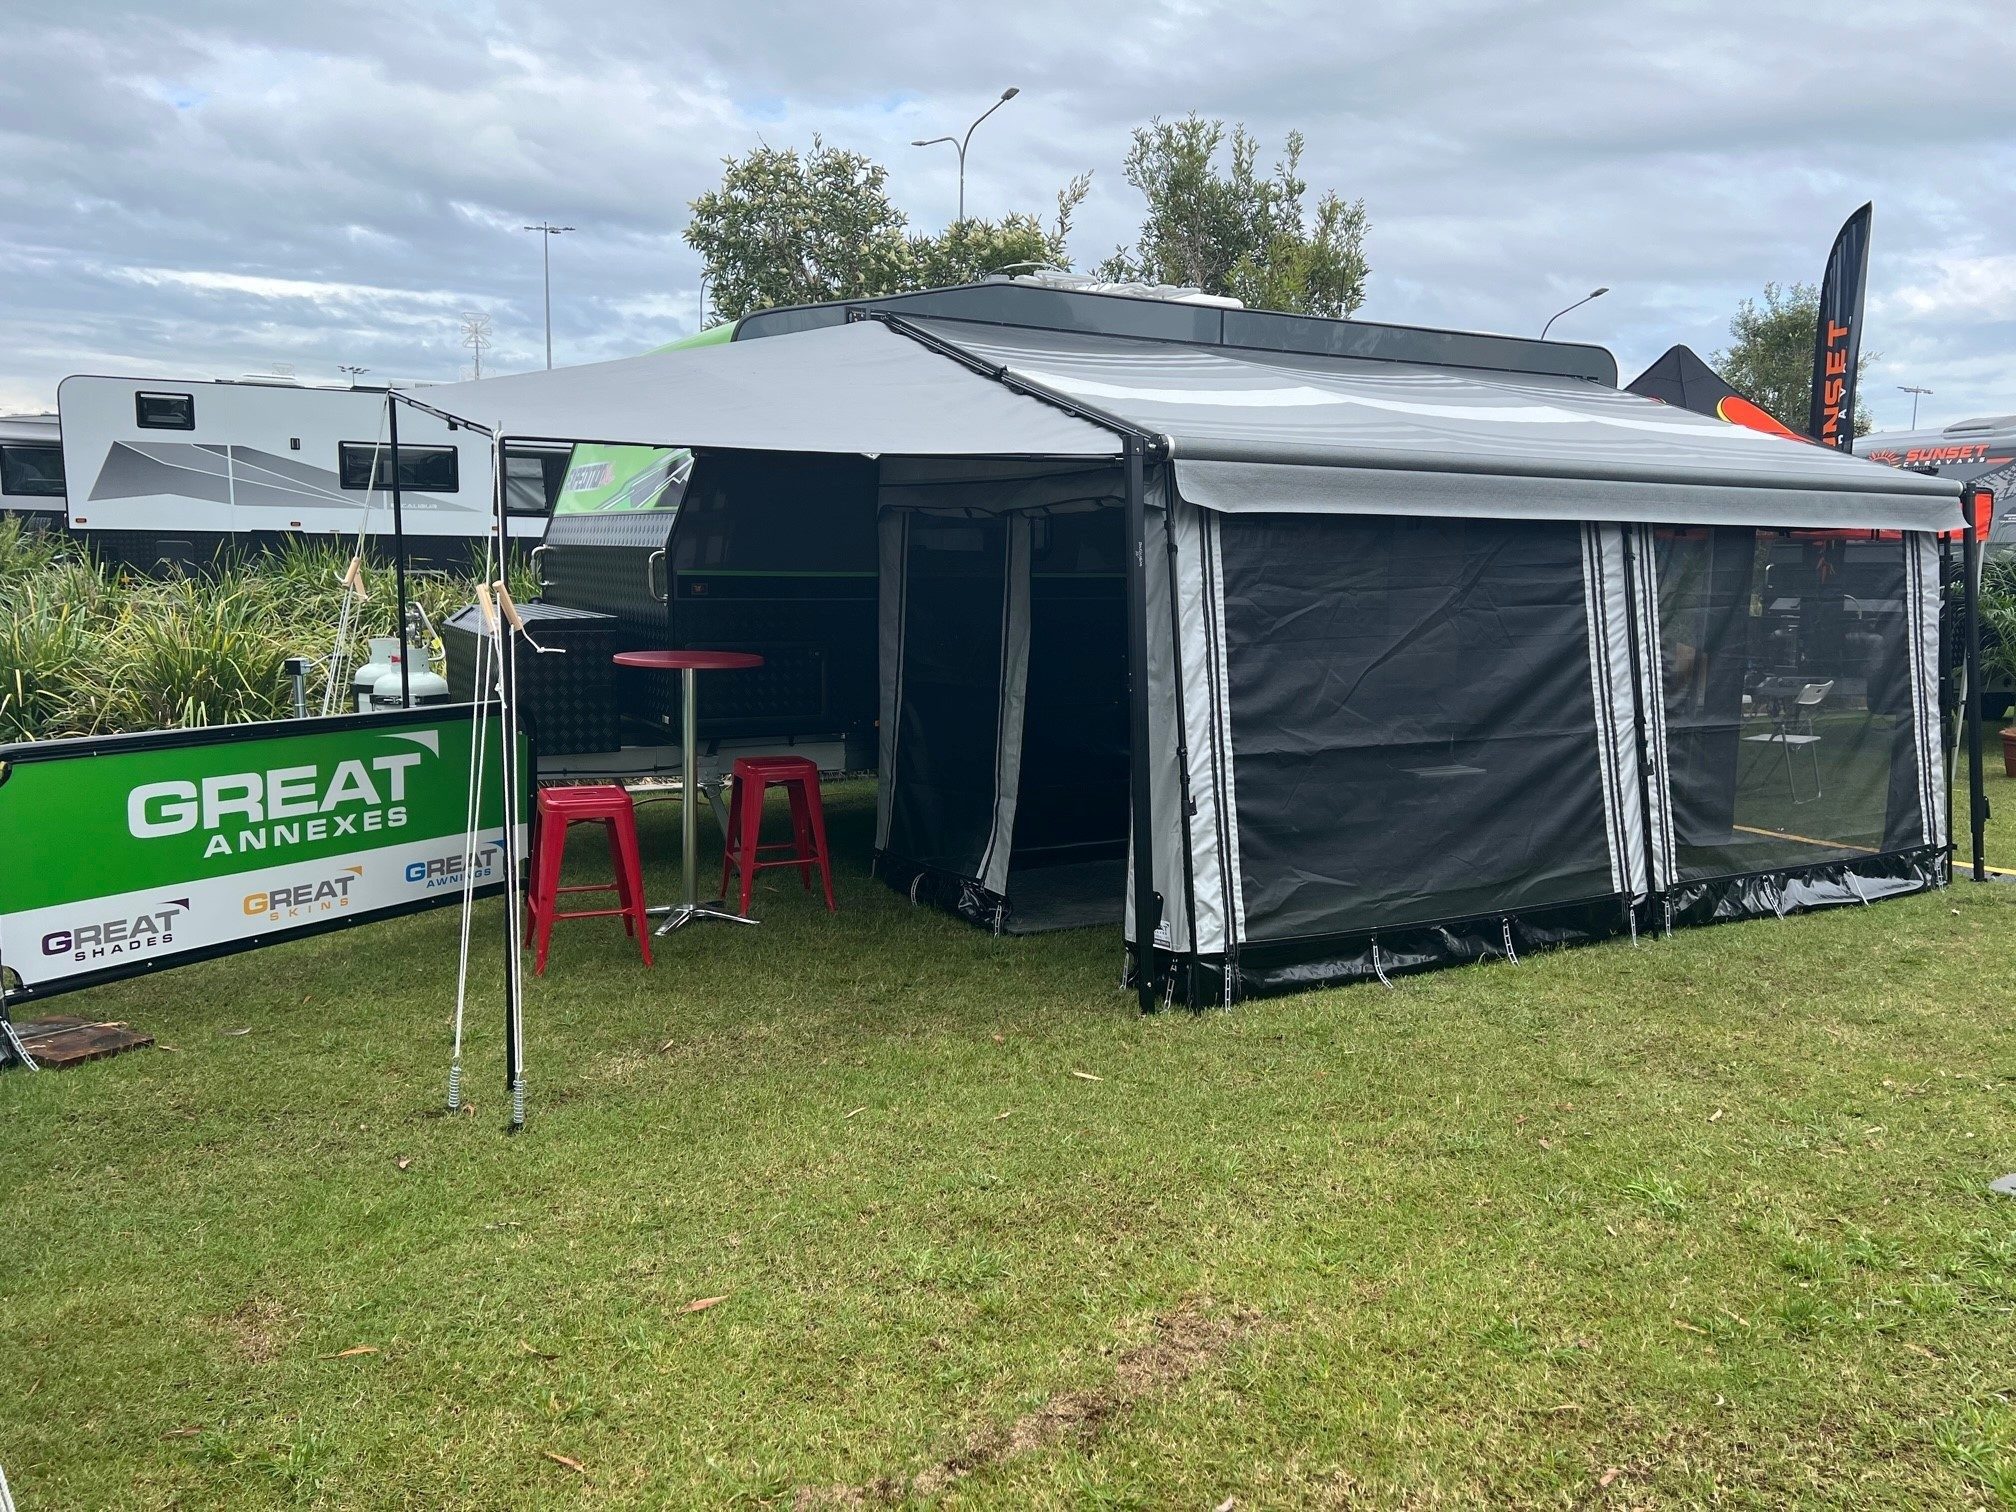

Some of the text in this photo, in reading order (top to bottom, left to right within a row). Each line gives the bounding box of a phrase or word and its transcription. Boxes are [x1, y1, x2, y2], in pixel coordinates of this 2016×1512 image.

[1903, 457, 1986, 467] CARAVANS
[1905, 444, 1990, 461] SUNSET
[127, 752, 422, 839] GREAT
[203, 806, 407, 859] ANNEXES
[405, 848, 498, 882] GREAT
[243, 875, 355, 916] GREAT
[269, 897, 349, 922] SKINS
[41, 908, 180, 956] GREAT
[74, 933, 173, 962] SHADES
